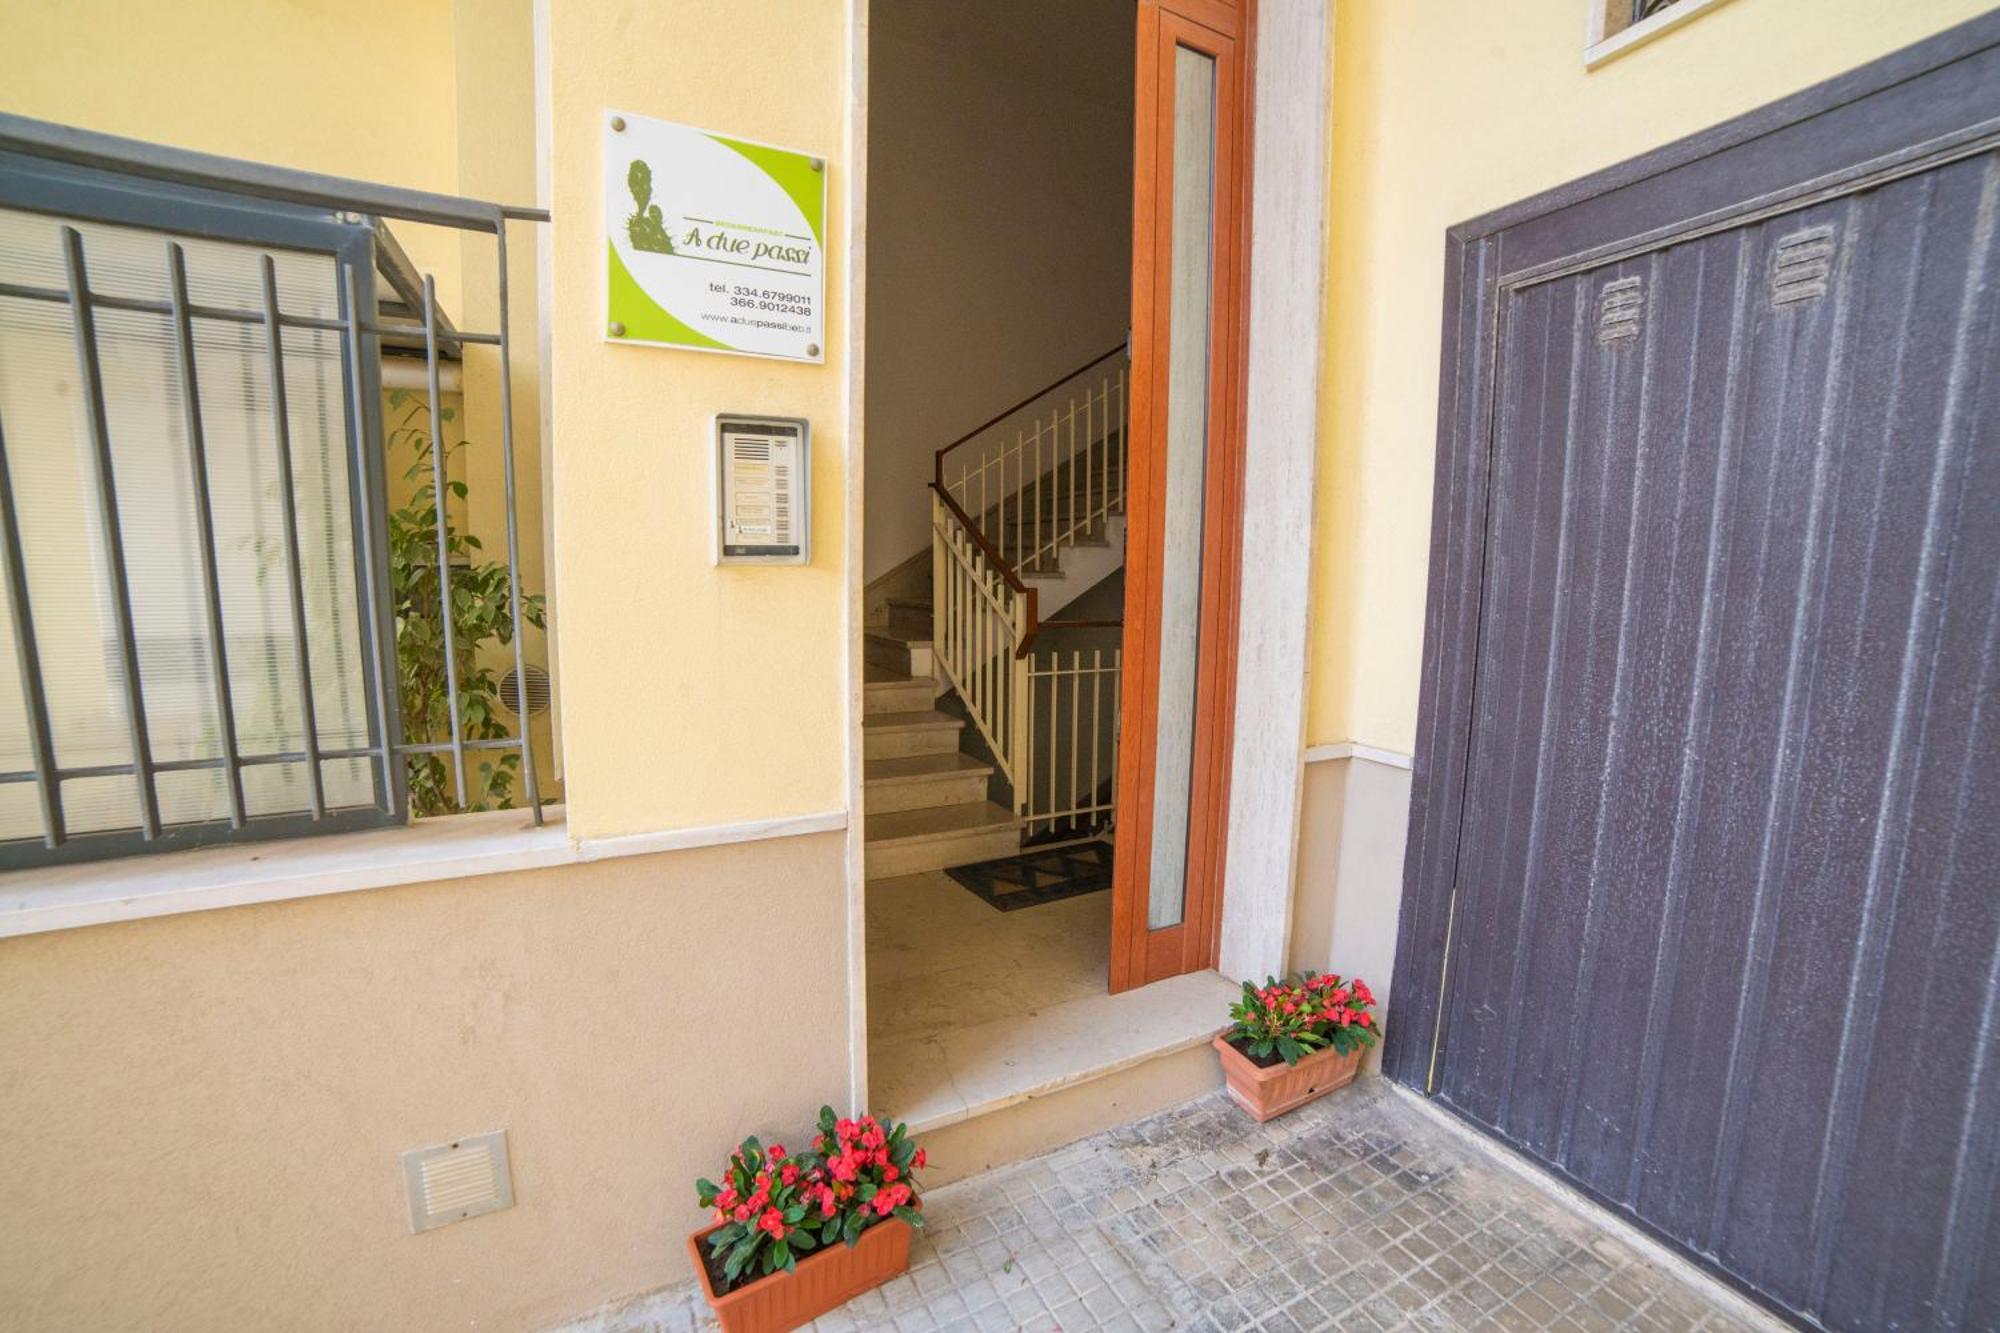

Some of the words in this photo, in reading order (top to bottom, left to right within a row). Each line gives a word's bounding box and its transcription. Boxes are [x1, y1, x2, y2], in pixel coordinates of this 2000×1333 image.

[683, 227, 702, 247] A
[706, 231, 750, 253] due
[751, 242, 812, 264] passi
[709, 282, 730, 294] tel.
[733, 286, 812, 305] 334.6799011
[730, 297, 812, 317] 366.9012438
